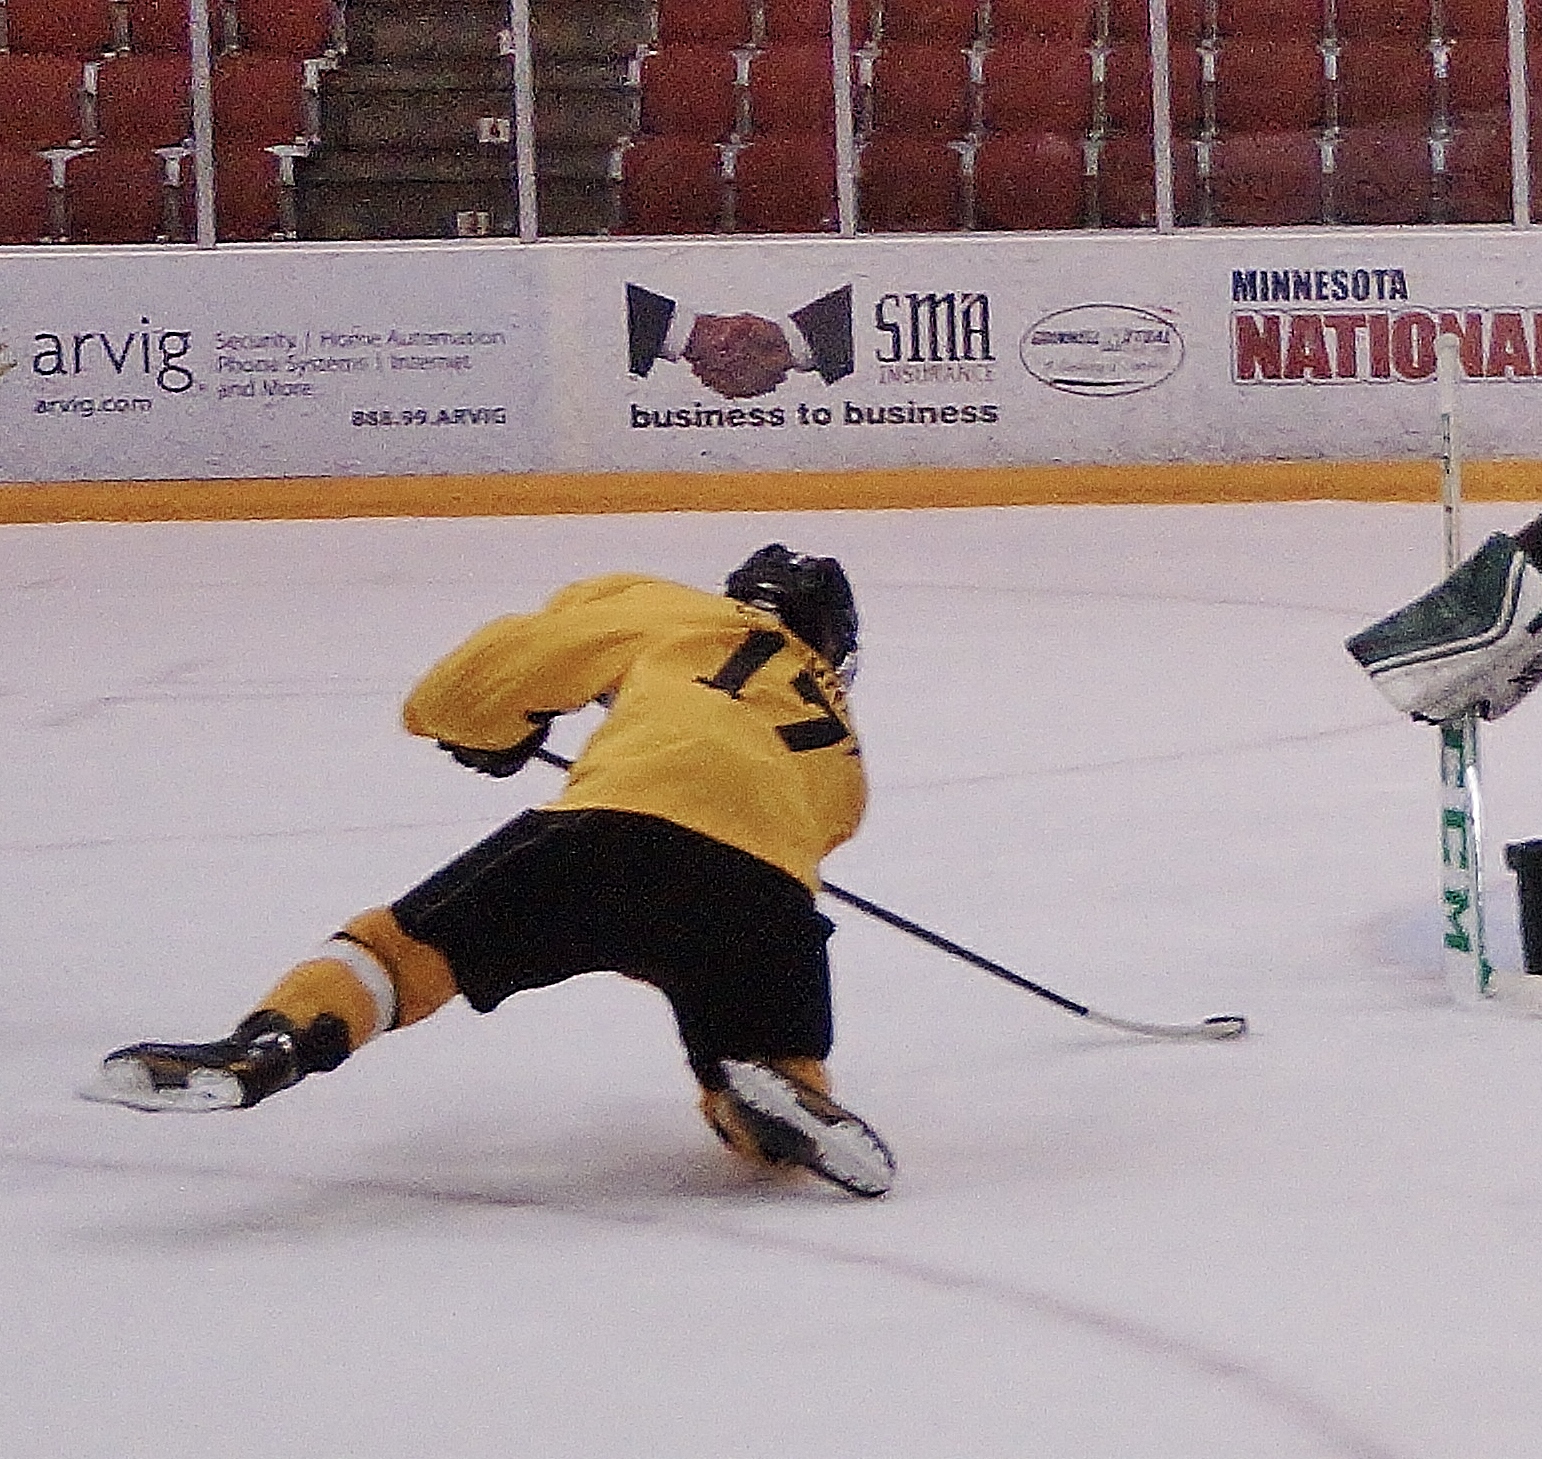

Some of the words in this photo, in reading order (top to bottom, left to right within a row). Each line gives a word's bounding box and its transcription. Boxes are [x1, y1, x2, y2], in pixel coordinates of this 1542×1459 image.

[1231, 268, 1408, 301] MINNESOTA
[875, 292, 996, 362] SMA
[215, 331, 297, 351] Security
[320, 332, 381, 347] Home
[386, 329, 506, 346] Automation
[33, 316, 193, 393] arvig
[217, 355, 279, 372] Phone
[286, 355, 369, 377] Systems
[390, 354, 474, 370] Internet
[879, 364, 996, 383] INSURANCE
[217, 379, 255, 399] and
[34, 396, 153, 417] arvig.com
[629, 403, 784, 428] business
[799, 402, 832, 425] to
[843, 401, 999, 424] business
[1441, 726, 1472, 952] CCM
